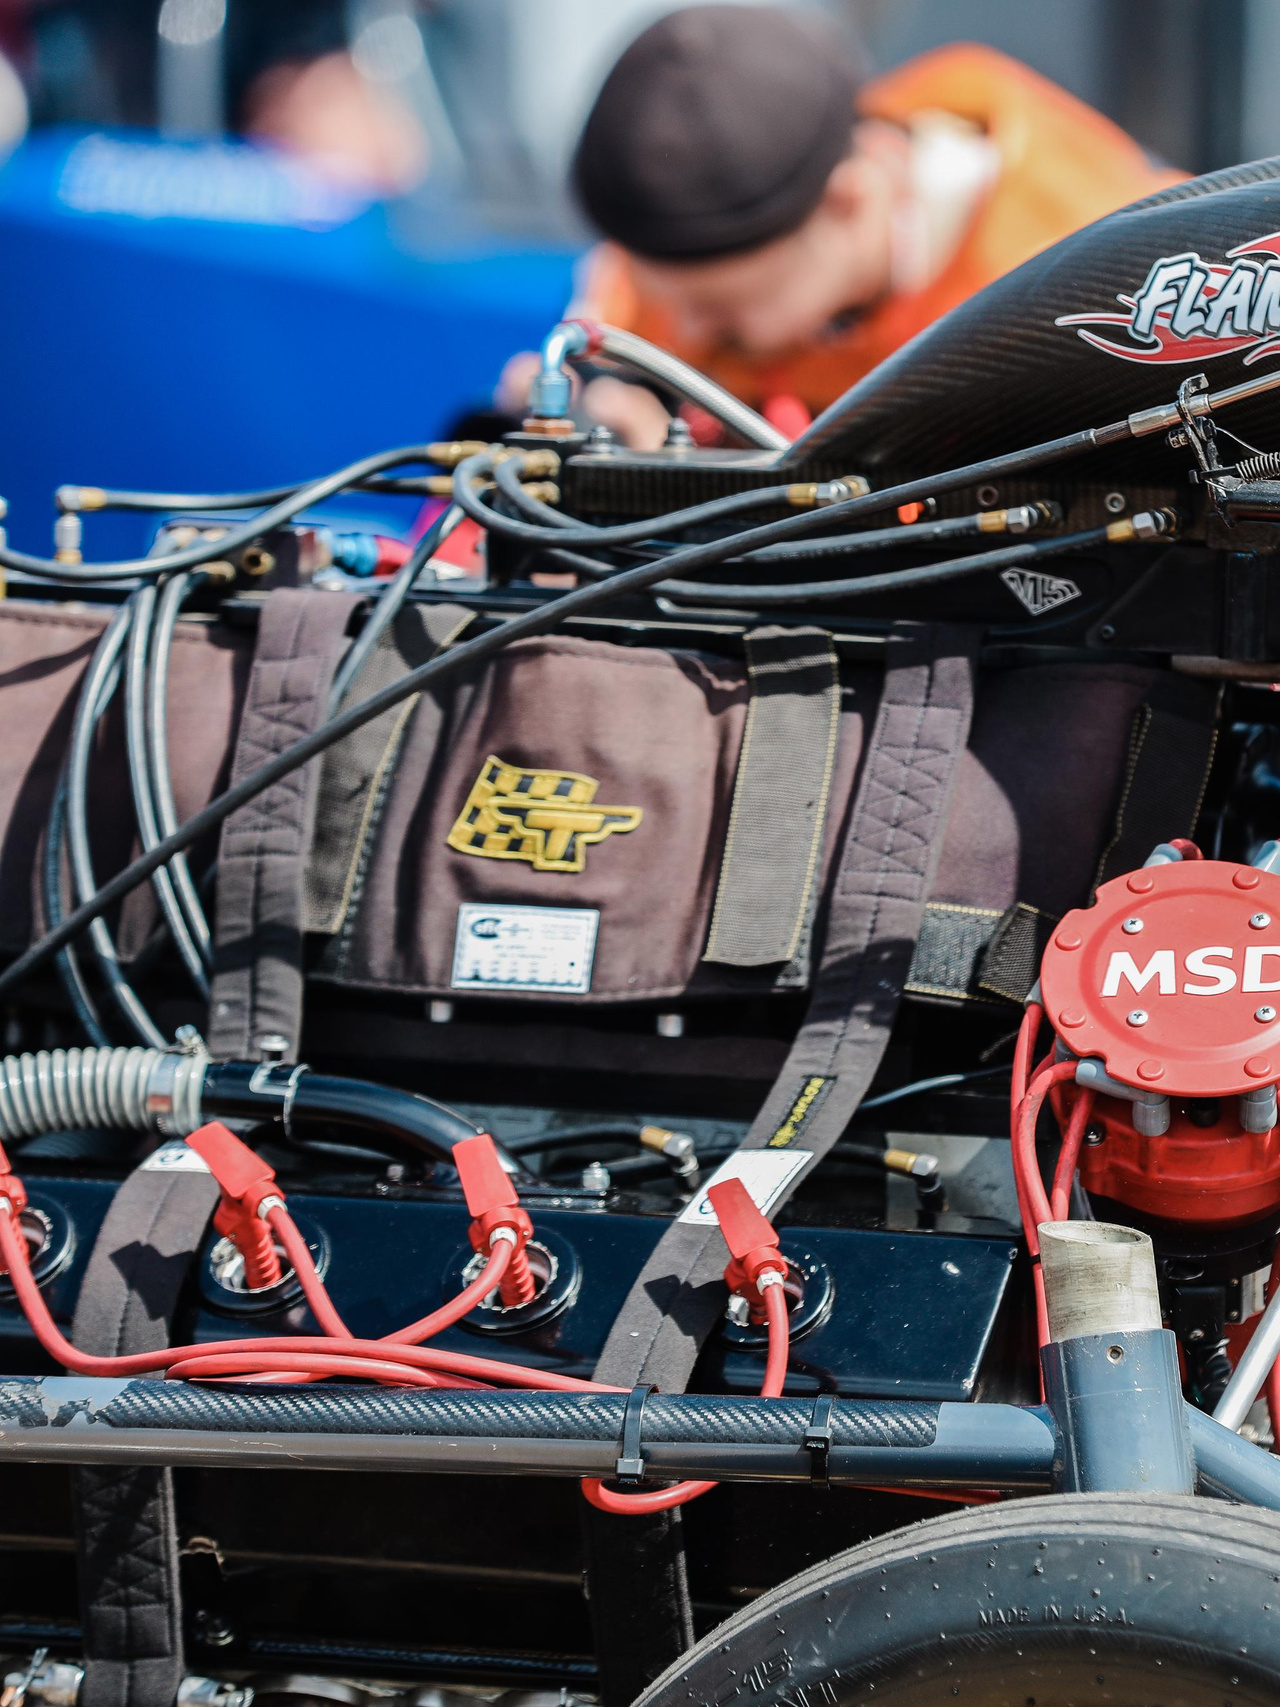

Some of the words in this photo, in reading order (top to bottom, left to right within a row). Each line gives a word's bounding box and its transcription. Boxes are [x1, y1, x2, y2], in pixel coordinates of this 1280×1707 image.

[978, 1606, 1031, 1626] MADE
[1044, 1604, 1063, 1622] IN
[1073, 1603, 1136, 1625] U.S.A.
